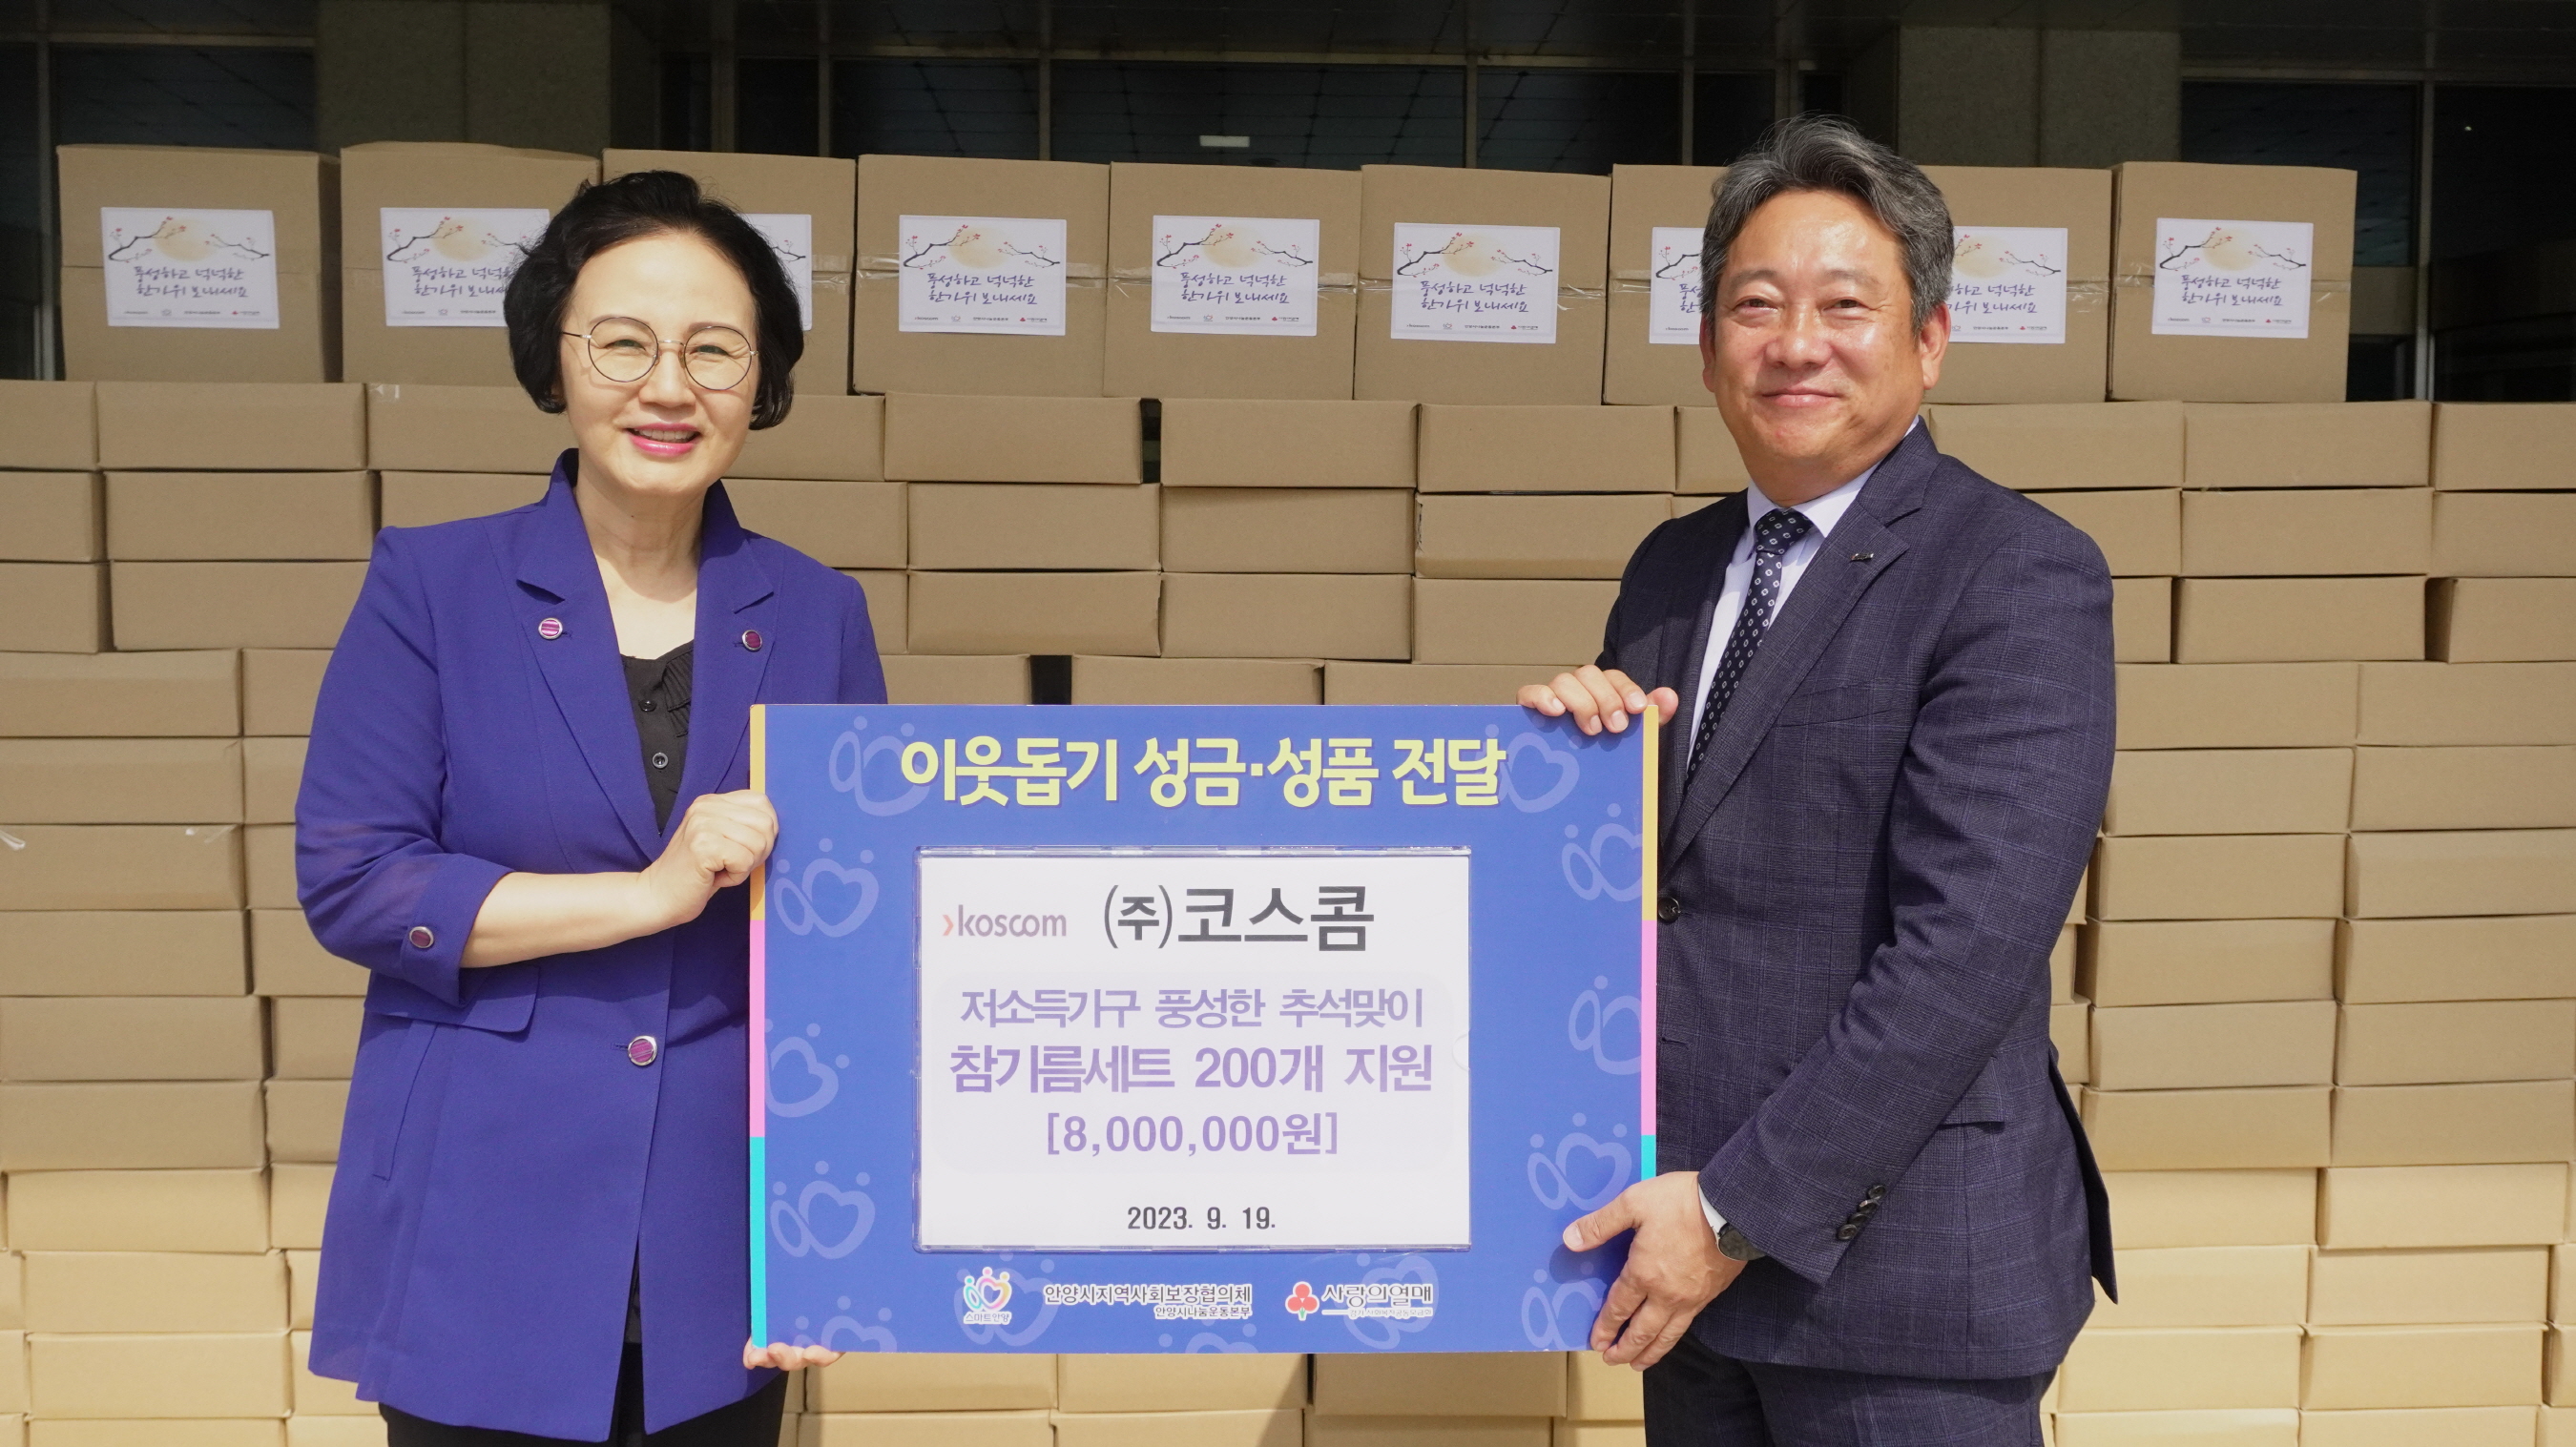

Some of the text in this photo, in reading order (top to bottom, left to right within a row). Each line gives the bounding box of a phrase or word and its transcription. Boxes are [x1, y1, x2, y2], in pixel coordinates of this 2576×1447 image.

[135, 265, 244, 283] 풍성하고 넉넉한
[412, 265, 467, 283] 풍성하고
[927, 273, 1035, 290] 풍성하고 넉넉한
[1180, 272, 1288, 289] 풍성하고 넉넉한
[137, 284, 248, 299] 한가위 보내세요
[414, 284, 463, 298] 한가위
[1421, 280, 1527, 298] 풍성하고 넉넉한
[1988, 284, 2036, 297] 넉넉한
[2182, 275, 2282, 291] 풍성하고 넉넉한
[928, 290, 1038, 305] 한가위 보내세요
[1181, 289, 1290, 304] 한가위 보내세요
[2182, 291, 2283, 306] 한가위 보내세요
[1422, 298, 1529, 313] 한가위 보내세요
[1947, 300, 2038, 315] 가위 보내세요
[902, 735, 1507, 808] 이웃돕기 성금·성품 전달
[958, 904, 1068, 938] koscom
[1104, 884, 1375, 952] (주)코스콤
[1155, 988, 1267, 1029] 풍성한
[1278, 988, 1423, 1028] 추석맞이
[949, 1044, 1433, 1094] 참기름세트 200개 지원
[1048, 1112, 1338, 1157] [8,000,000원]
[1128, 1206, 1277, 1230] 2023. 9. 19.
[1044, 1285, 1252, 1304] 안양시지역사회보장협의체
[1322, 1285, 1432, 1308] 사랑의열매
[965, 1312, 1010, 1323] 스마트안양
[1154, 1306, 1252, 1317] 안양시나눔운동본부
